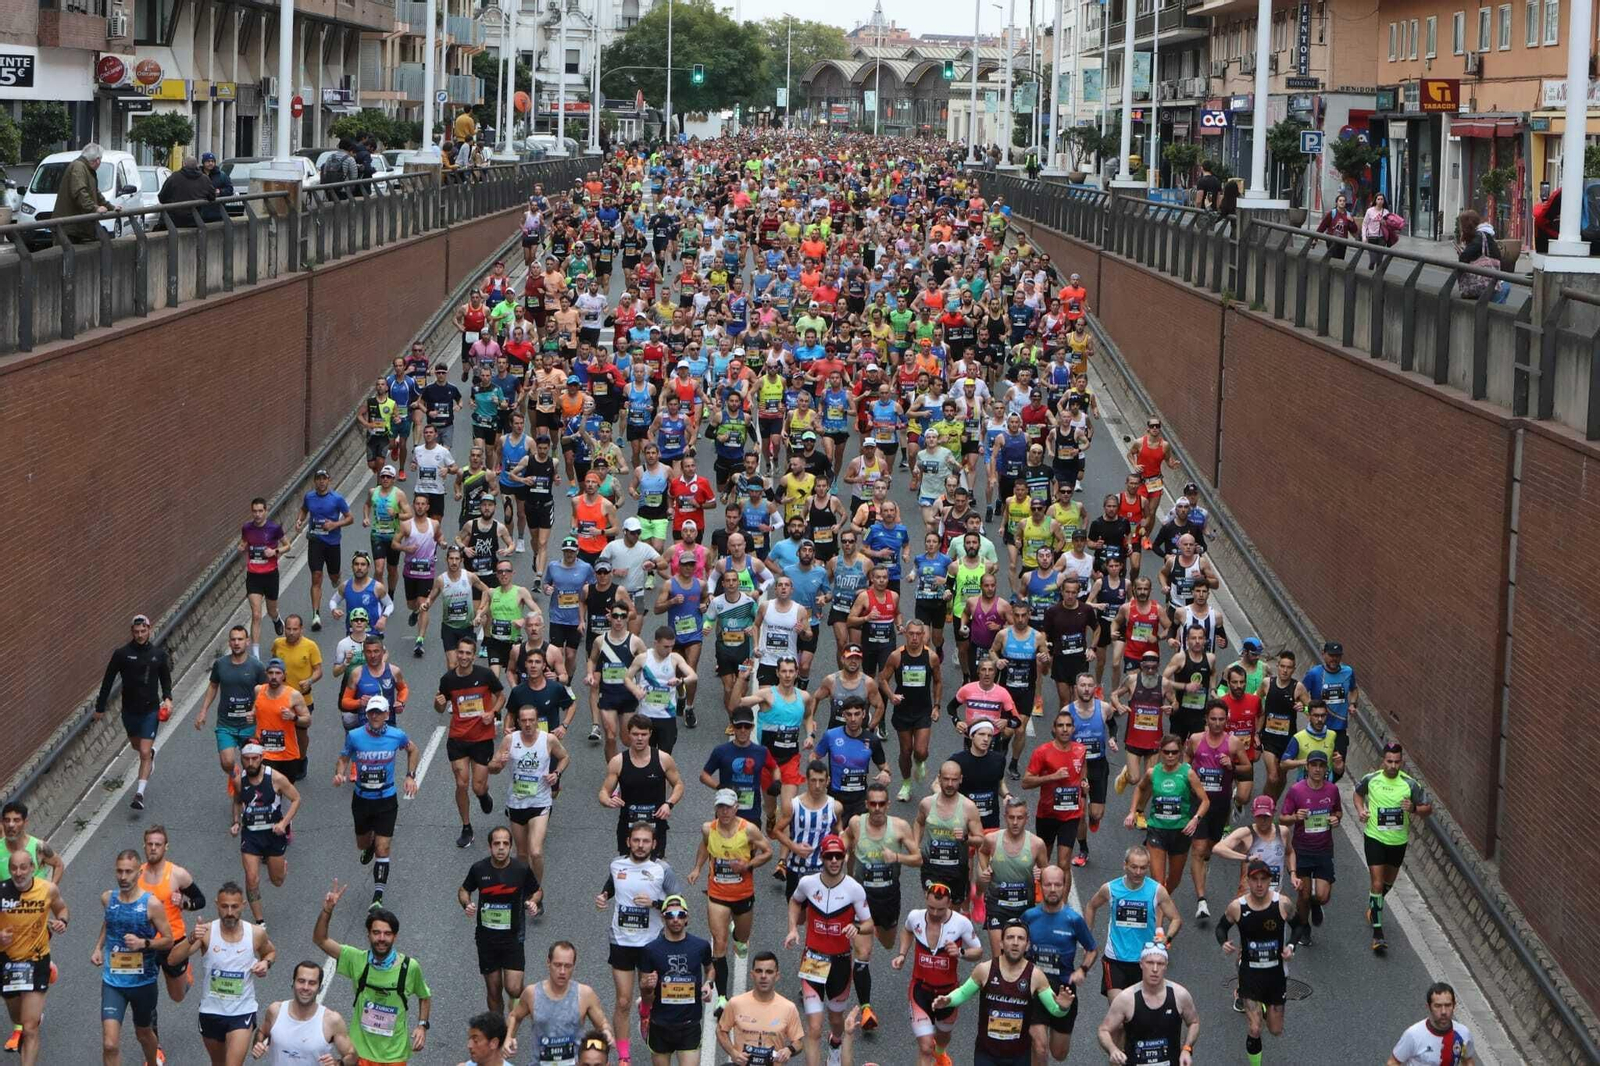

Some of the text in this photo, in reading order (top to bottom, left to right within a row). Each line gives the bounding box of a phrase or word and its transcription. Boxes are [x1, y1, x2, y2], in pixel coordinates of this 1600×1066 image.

[968, 701, 1000, 709] TREK
[2, 898, 45, 908] bichos
[376, 1004, 394, 1013] ZURICH
